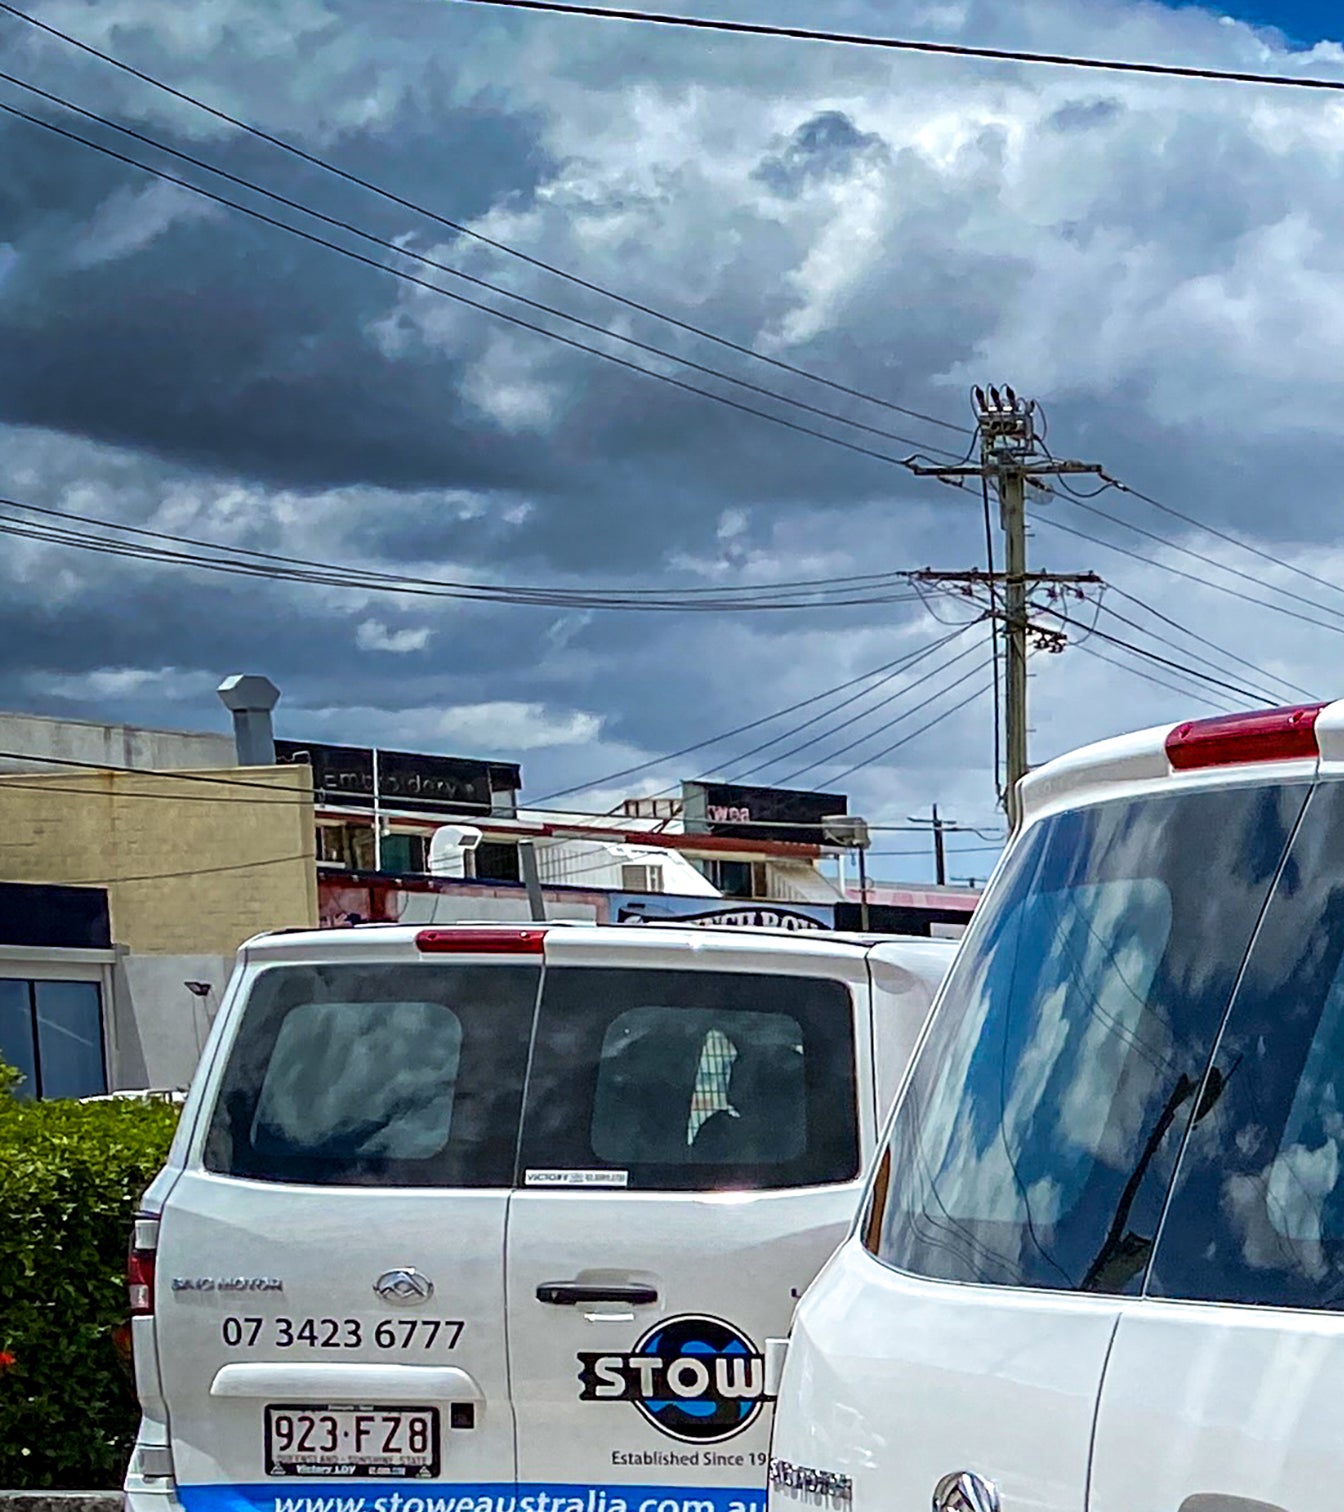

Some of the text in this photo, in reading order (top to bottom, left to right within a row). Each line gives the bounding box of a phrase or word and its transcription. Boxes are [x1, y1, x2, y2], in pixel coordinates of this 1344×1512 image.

[222, 1316, 466, 1350] 07 3423 6777
[594, 1356, 764, 1398] STOW
[611, 1450, 700, 1466] Established
[703, 1452, 744, 1467] Since
